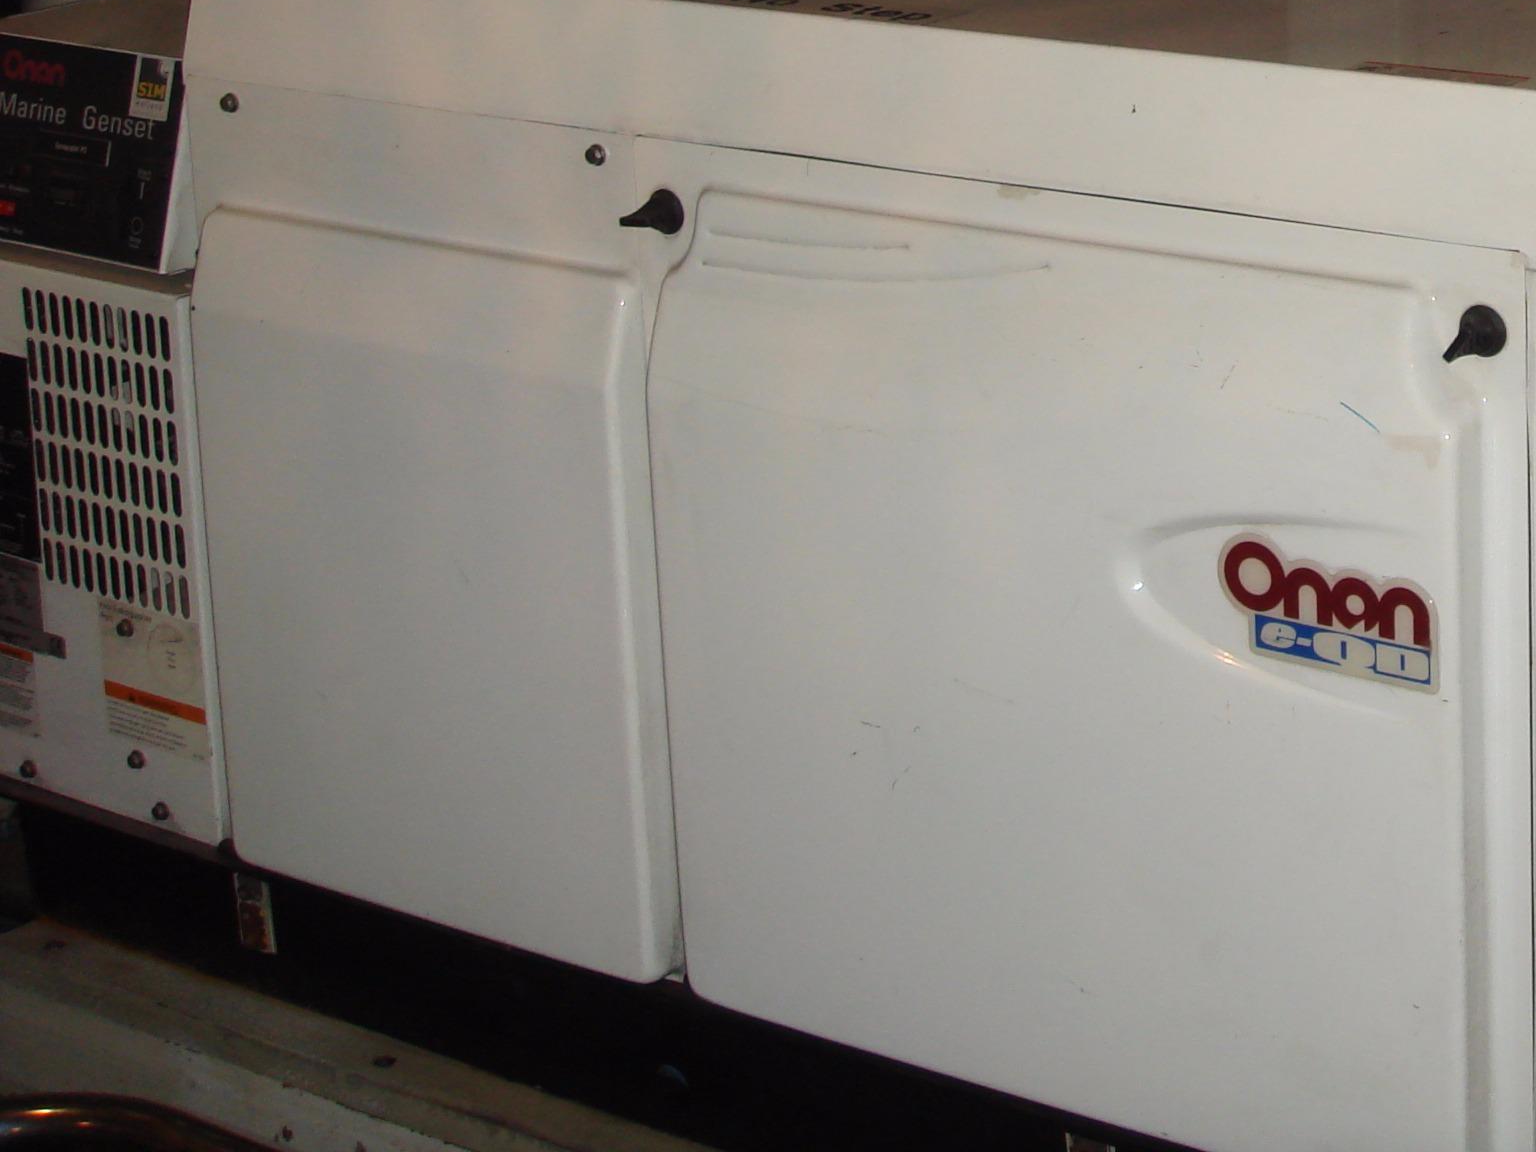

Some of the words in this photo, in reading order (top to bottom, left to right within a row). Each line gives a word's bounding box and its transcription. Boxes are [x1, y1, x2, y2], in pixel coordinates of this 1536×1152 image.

[820, 2, 932, 21] Step
[4, 50, 65, 87] Onan
[137, 80, 167, 100] SIM
[0, 91, 67, 125] Marine
[83, 105, 155, 140] Genset
[1224, 541, 1431, 648] Onan
